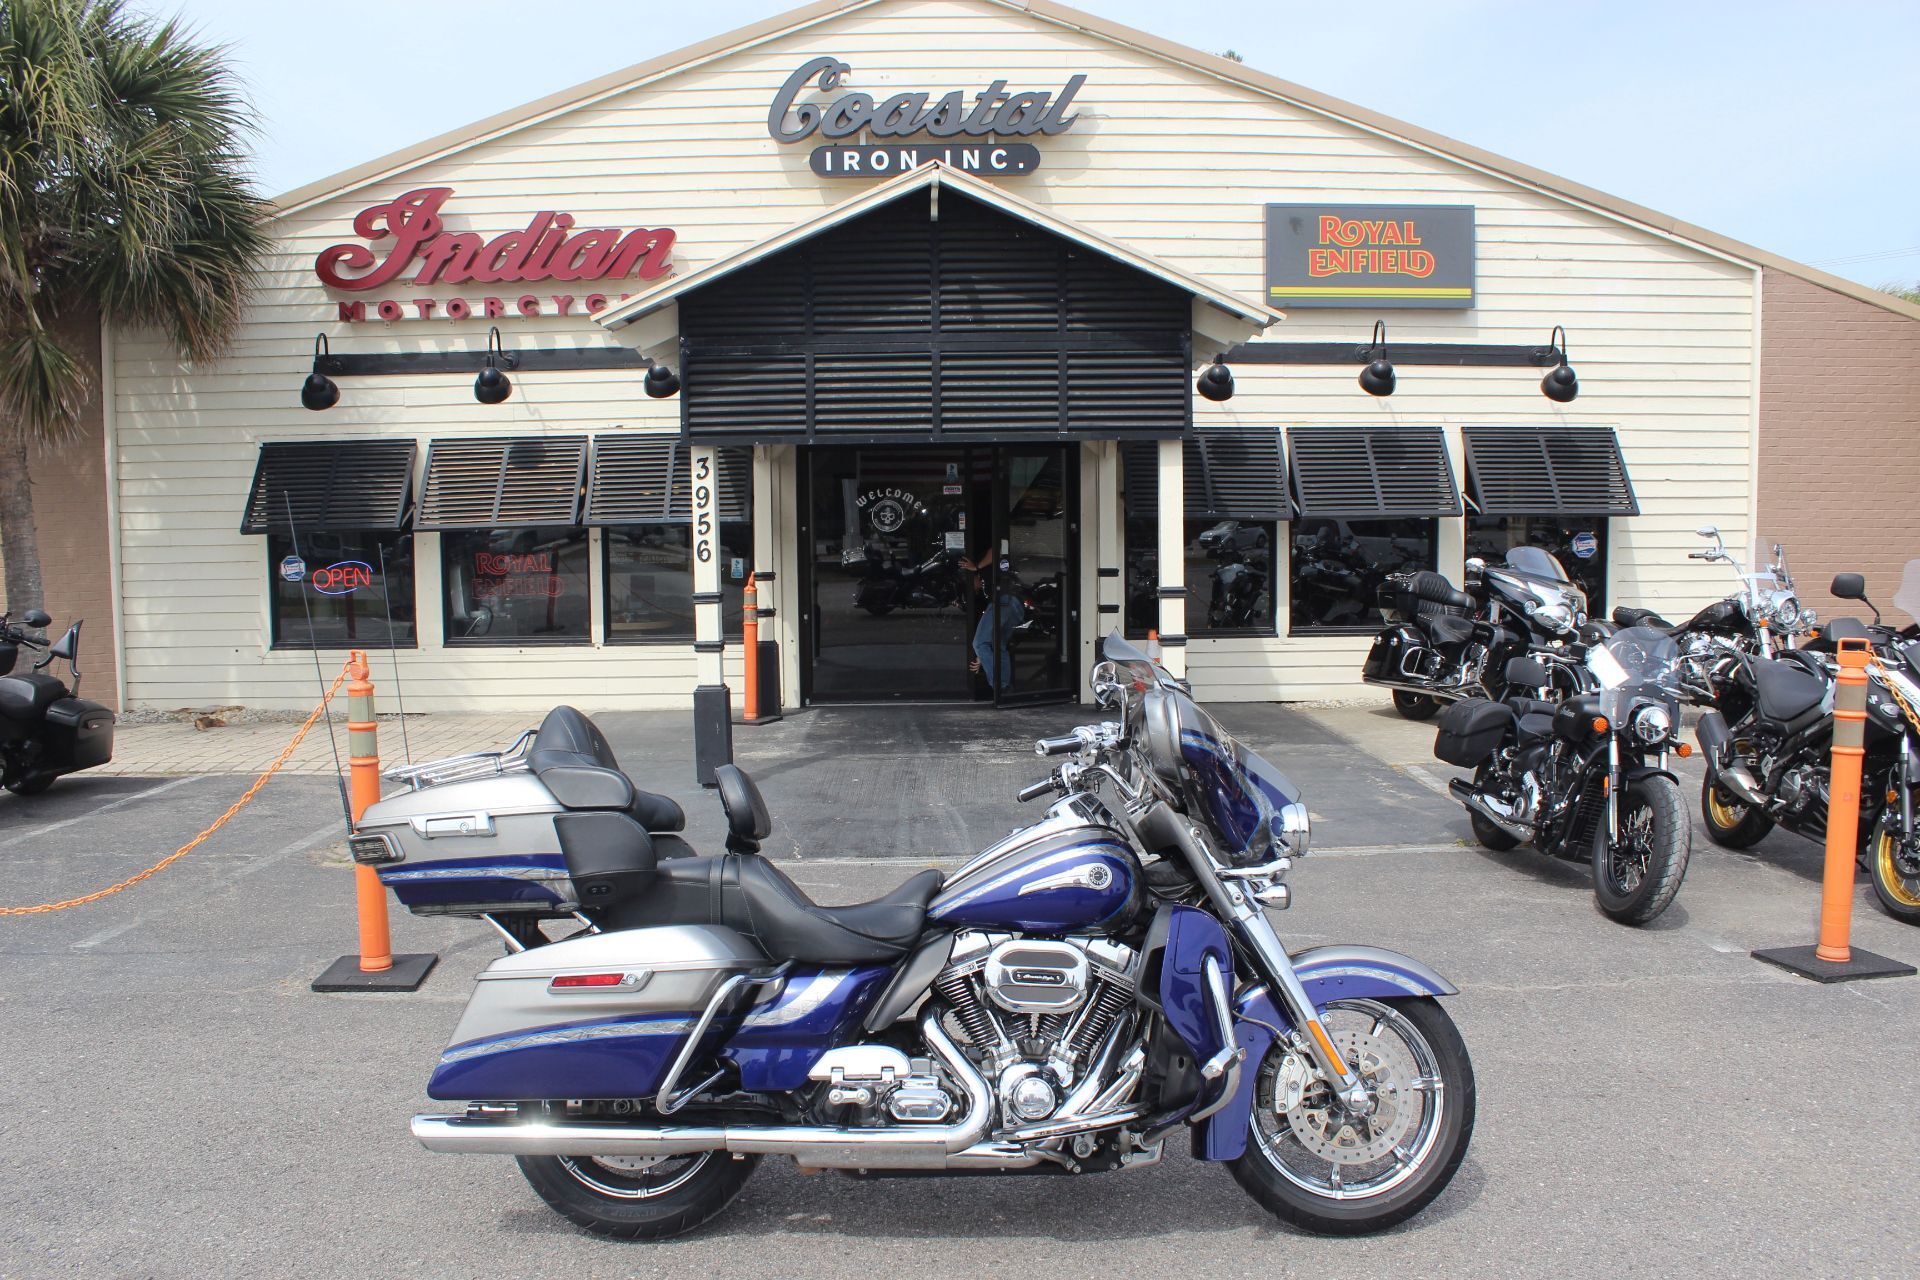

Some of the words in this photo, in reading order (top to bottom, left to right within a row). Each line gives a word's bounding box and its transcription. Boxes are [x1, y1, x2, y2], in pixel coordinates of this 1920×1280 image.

[767, 56, 1088, 144] Coastal
[825, 150, 917, 171] IRON
[944, 149, 1024, 170] INC.
[315, 187, 679, 291] Indian
[1318, 215, 1421, 247] ROYAL
[1308, 249, 1435, 278] ENFIELD
[339, 293, 631, 322] MOTORCYC
[694, 456, 712, 563] 3956
[312, 567, 371, 588] OPEN
[475, 552, 553, 576] ROYAL
[471, 576, 566, 599] ENFIELD
